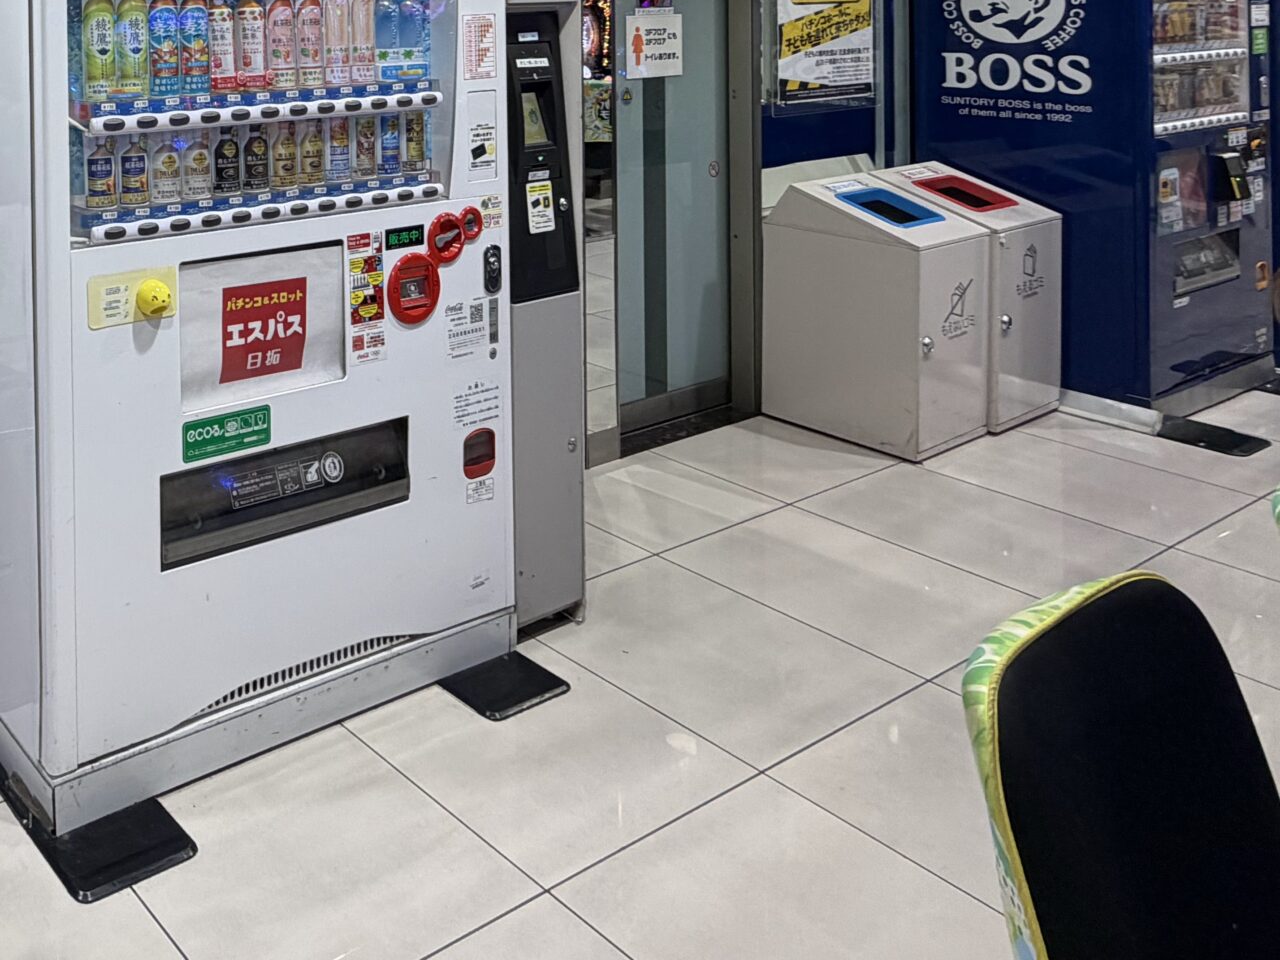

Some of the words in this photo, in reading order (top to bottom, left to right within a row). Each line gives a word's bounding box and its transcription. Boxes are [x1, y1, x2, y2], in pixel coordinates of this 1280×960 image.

[949, 20, 983, 49] BOSS
[1042, 8, 1085, 51] COFFEE
[941, 52, 1092, 95] BOSS
[941, 95, 996, 106] SUNTORY
[998, 99, 1030, 109] BOSS
[1033, 100, 1043, 109] is
[1045, 101, 1062, 111] the
[1065, 103, 1093, 113] boss
[959, 107, 969, 116] of
[971, 108, 997, 117] them
[999, 110, 1012, 118] all
[1014, 111, 1043, 120] since
[1046, 113, 1072, 122] 1992
[226, 290, 303, 311] パチンコ&スロット
[226, 311, 303, 347] エスパス
[246, 348, 281, 370] 日拓
